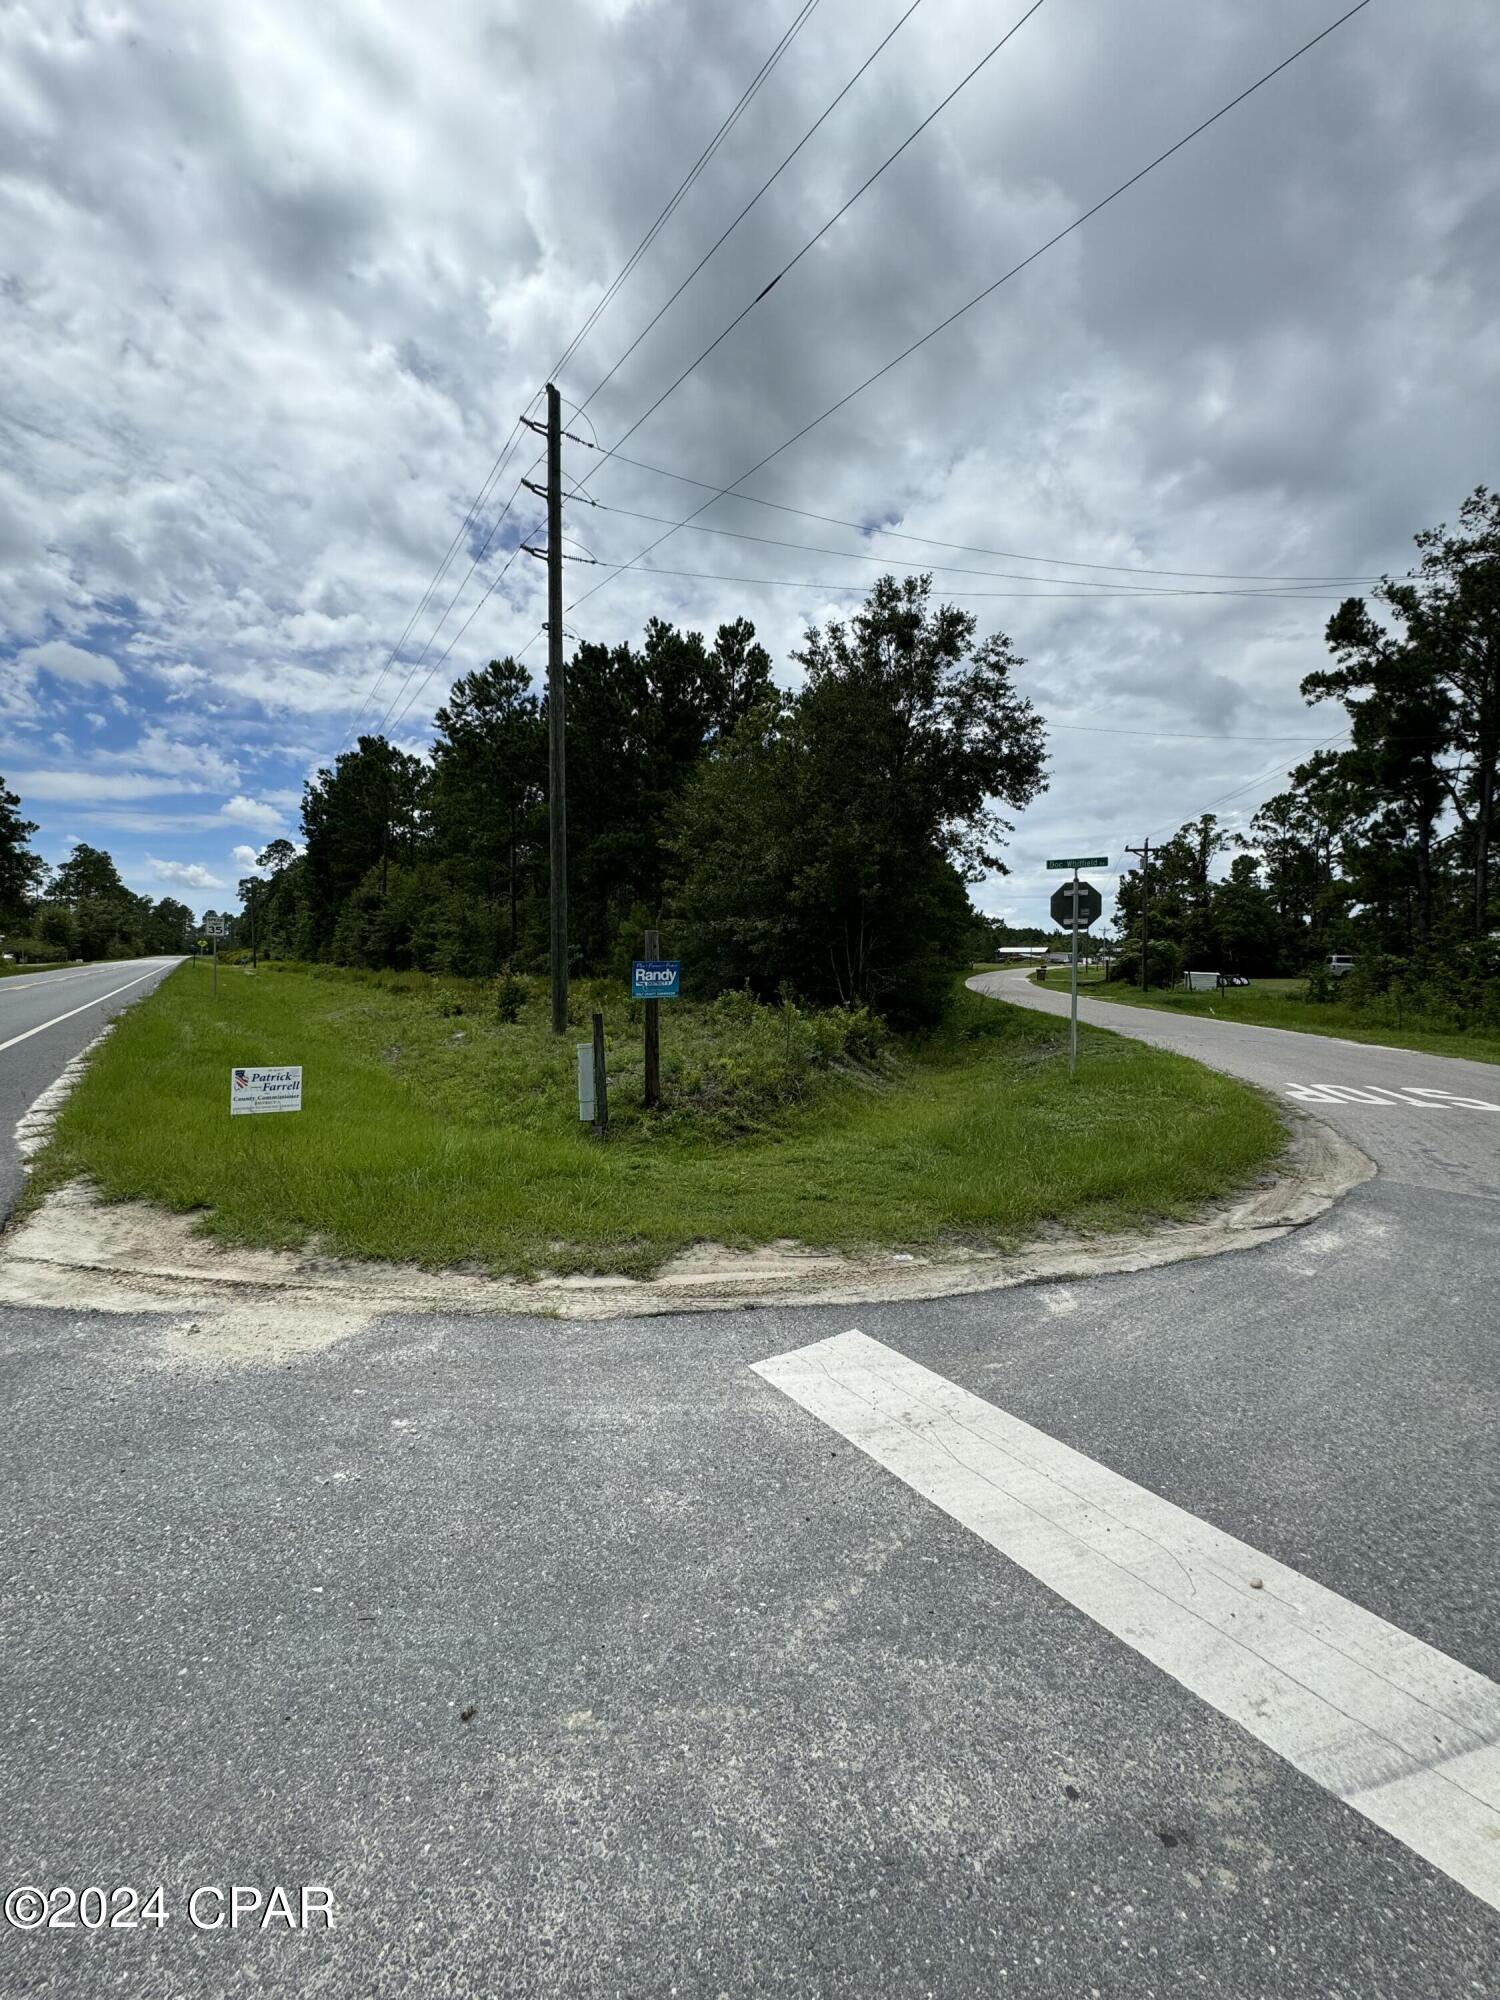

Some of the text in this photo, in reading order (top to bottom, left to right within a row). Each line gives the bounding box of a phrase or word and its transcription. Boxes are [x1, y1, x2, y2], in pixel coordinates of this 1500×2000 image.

[1049, 861, 1063, 869] Doc
[208, 926, 223, 934] 35
[635, 968, 677, 986] Randy
[251, 1072, 291, 1082] Patrick
[262, 1081, 300, 1091] Farrell
[1284, 1082, 1500, 1112] STOP
